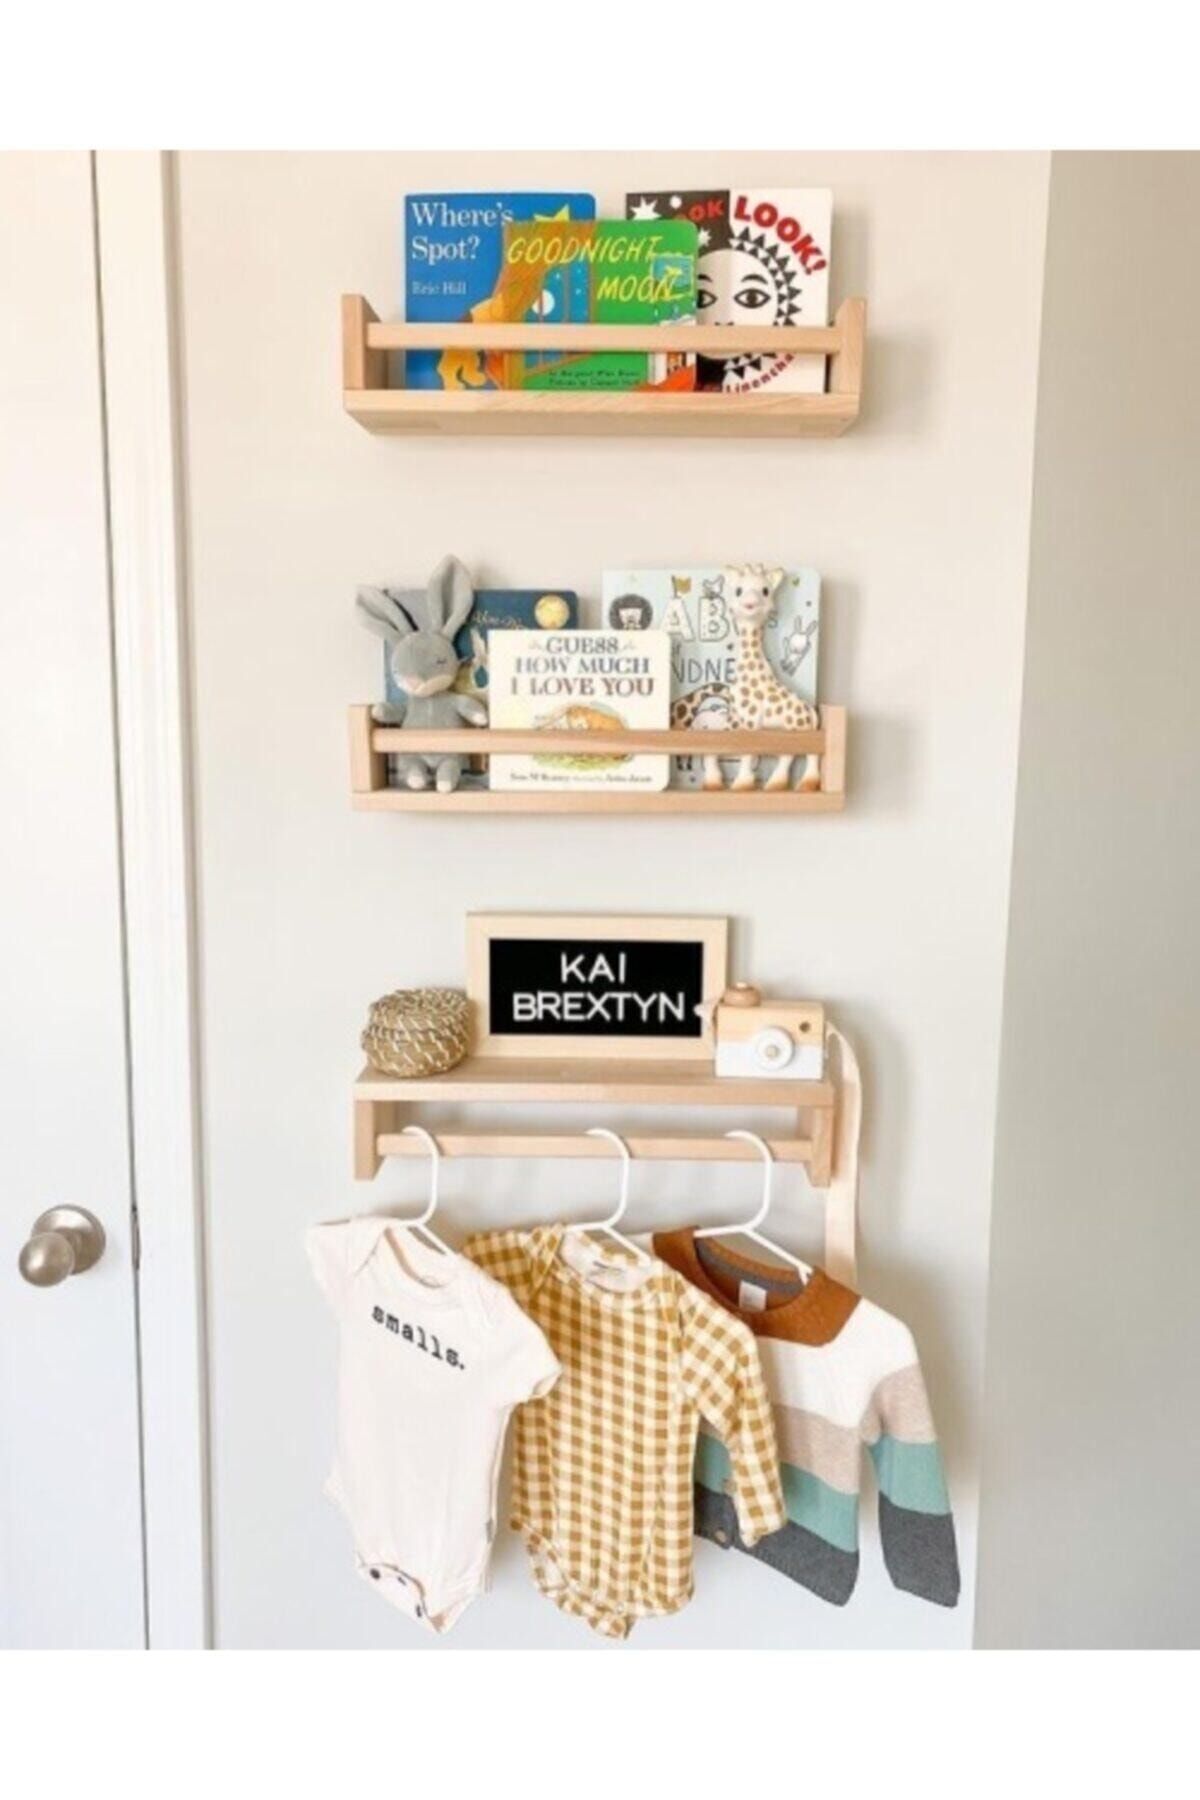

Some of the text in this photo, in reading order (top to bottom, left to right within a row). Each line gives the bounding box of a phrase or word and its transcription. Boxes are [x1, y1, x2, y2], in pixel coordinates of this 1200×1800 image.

[411, 202, 514, 227] Where's
[734, 196, 827, 275] LOOK!
[411, 236, 480, 265] Spot?
[507, 236, 662, 264] GOODNIGHT
[412, 282, 467, 295] Eric Hill
[597, 275, 678, 302] MOON
[515, 657, 649, 674] HOW MUCH
[511, 677, 655, 696] I LOVE YOU
[561, 953, 626, 983] KAI
[513, 991, 684, 1022] BREXTYN
[371, 1305, 466, 1370] smalls.
